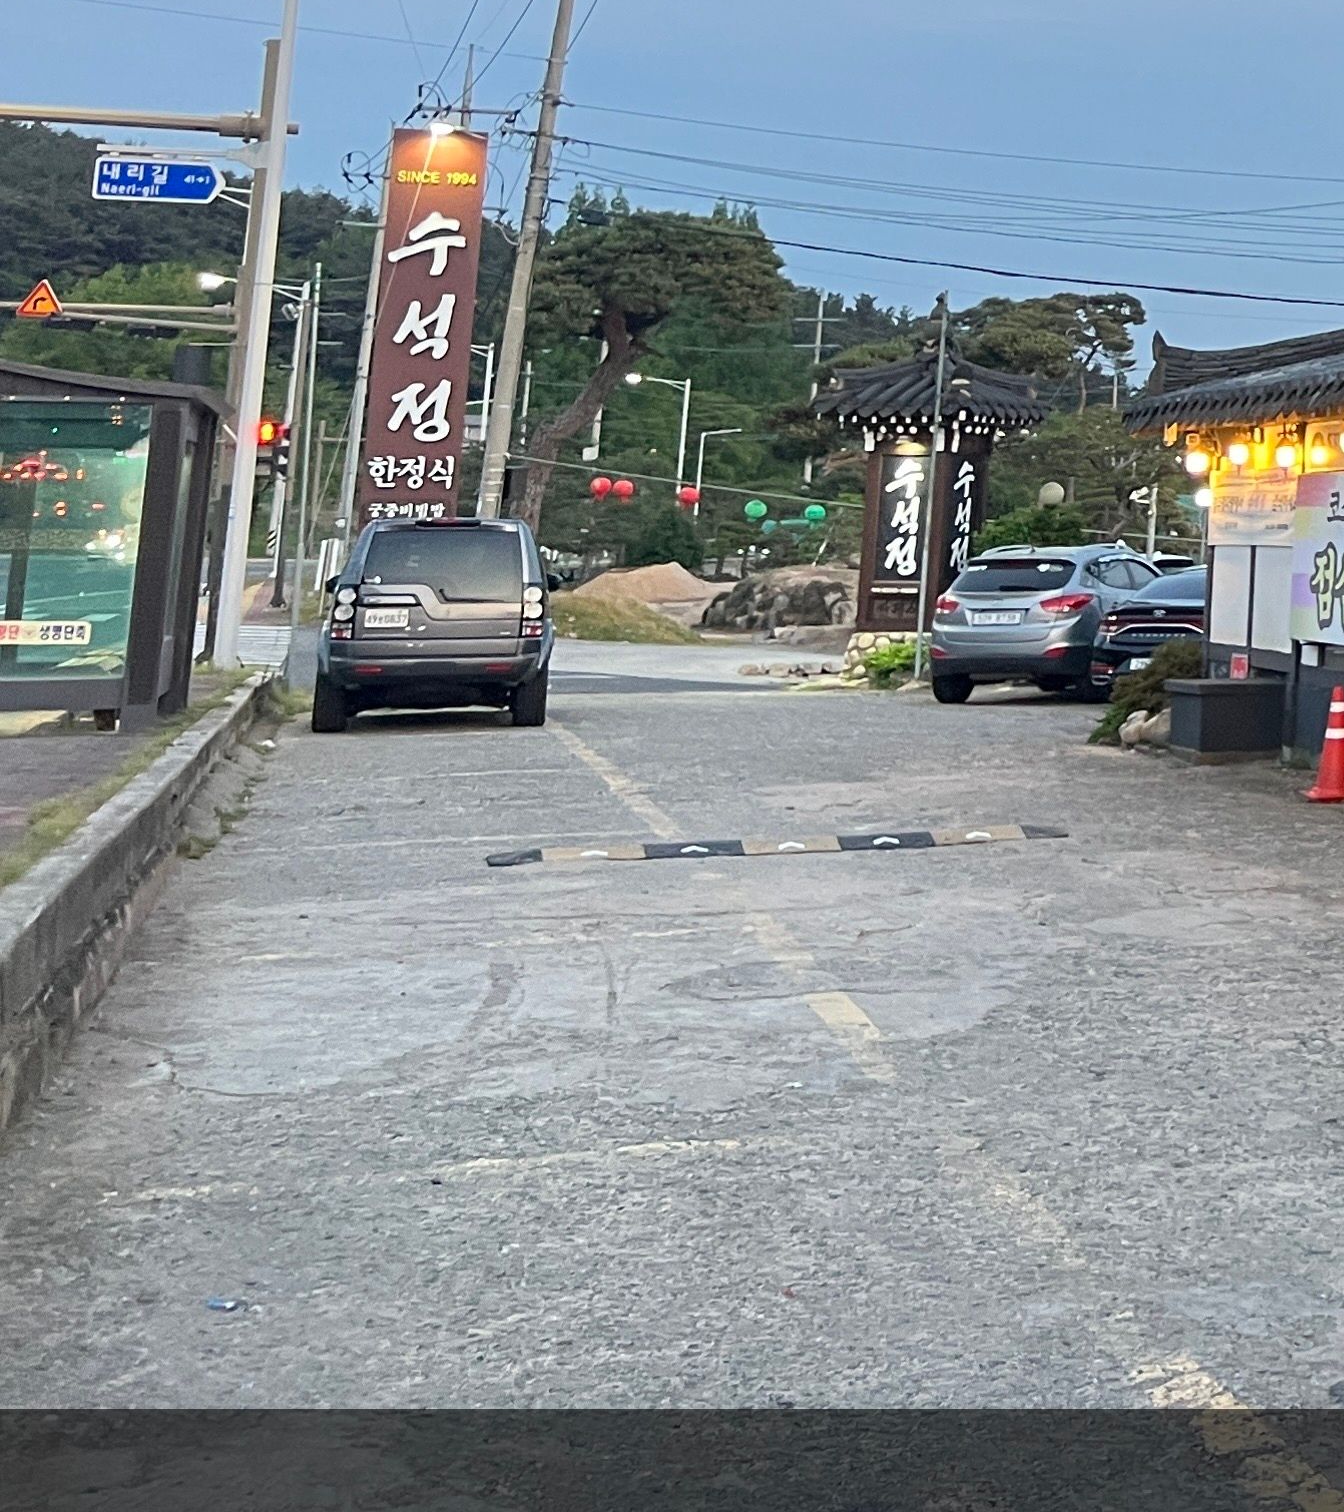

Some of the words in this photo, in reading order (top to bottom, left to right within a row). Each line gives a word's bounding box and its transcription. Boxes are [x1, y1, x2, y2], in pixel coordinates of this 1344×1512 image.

[102, 162, 168, 185] 내리길
[397, 170, 441, 185] SINCE
[446, 171, 477, 186] 1994
[100, 183, 160, 197] Naeri-gil
[387, 210, 467, 443] 수석정
[367, 455, 455, 490] 한정식
[885, 458, 925, 577] 수석정
